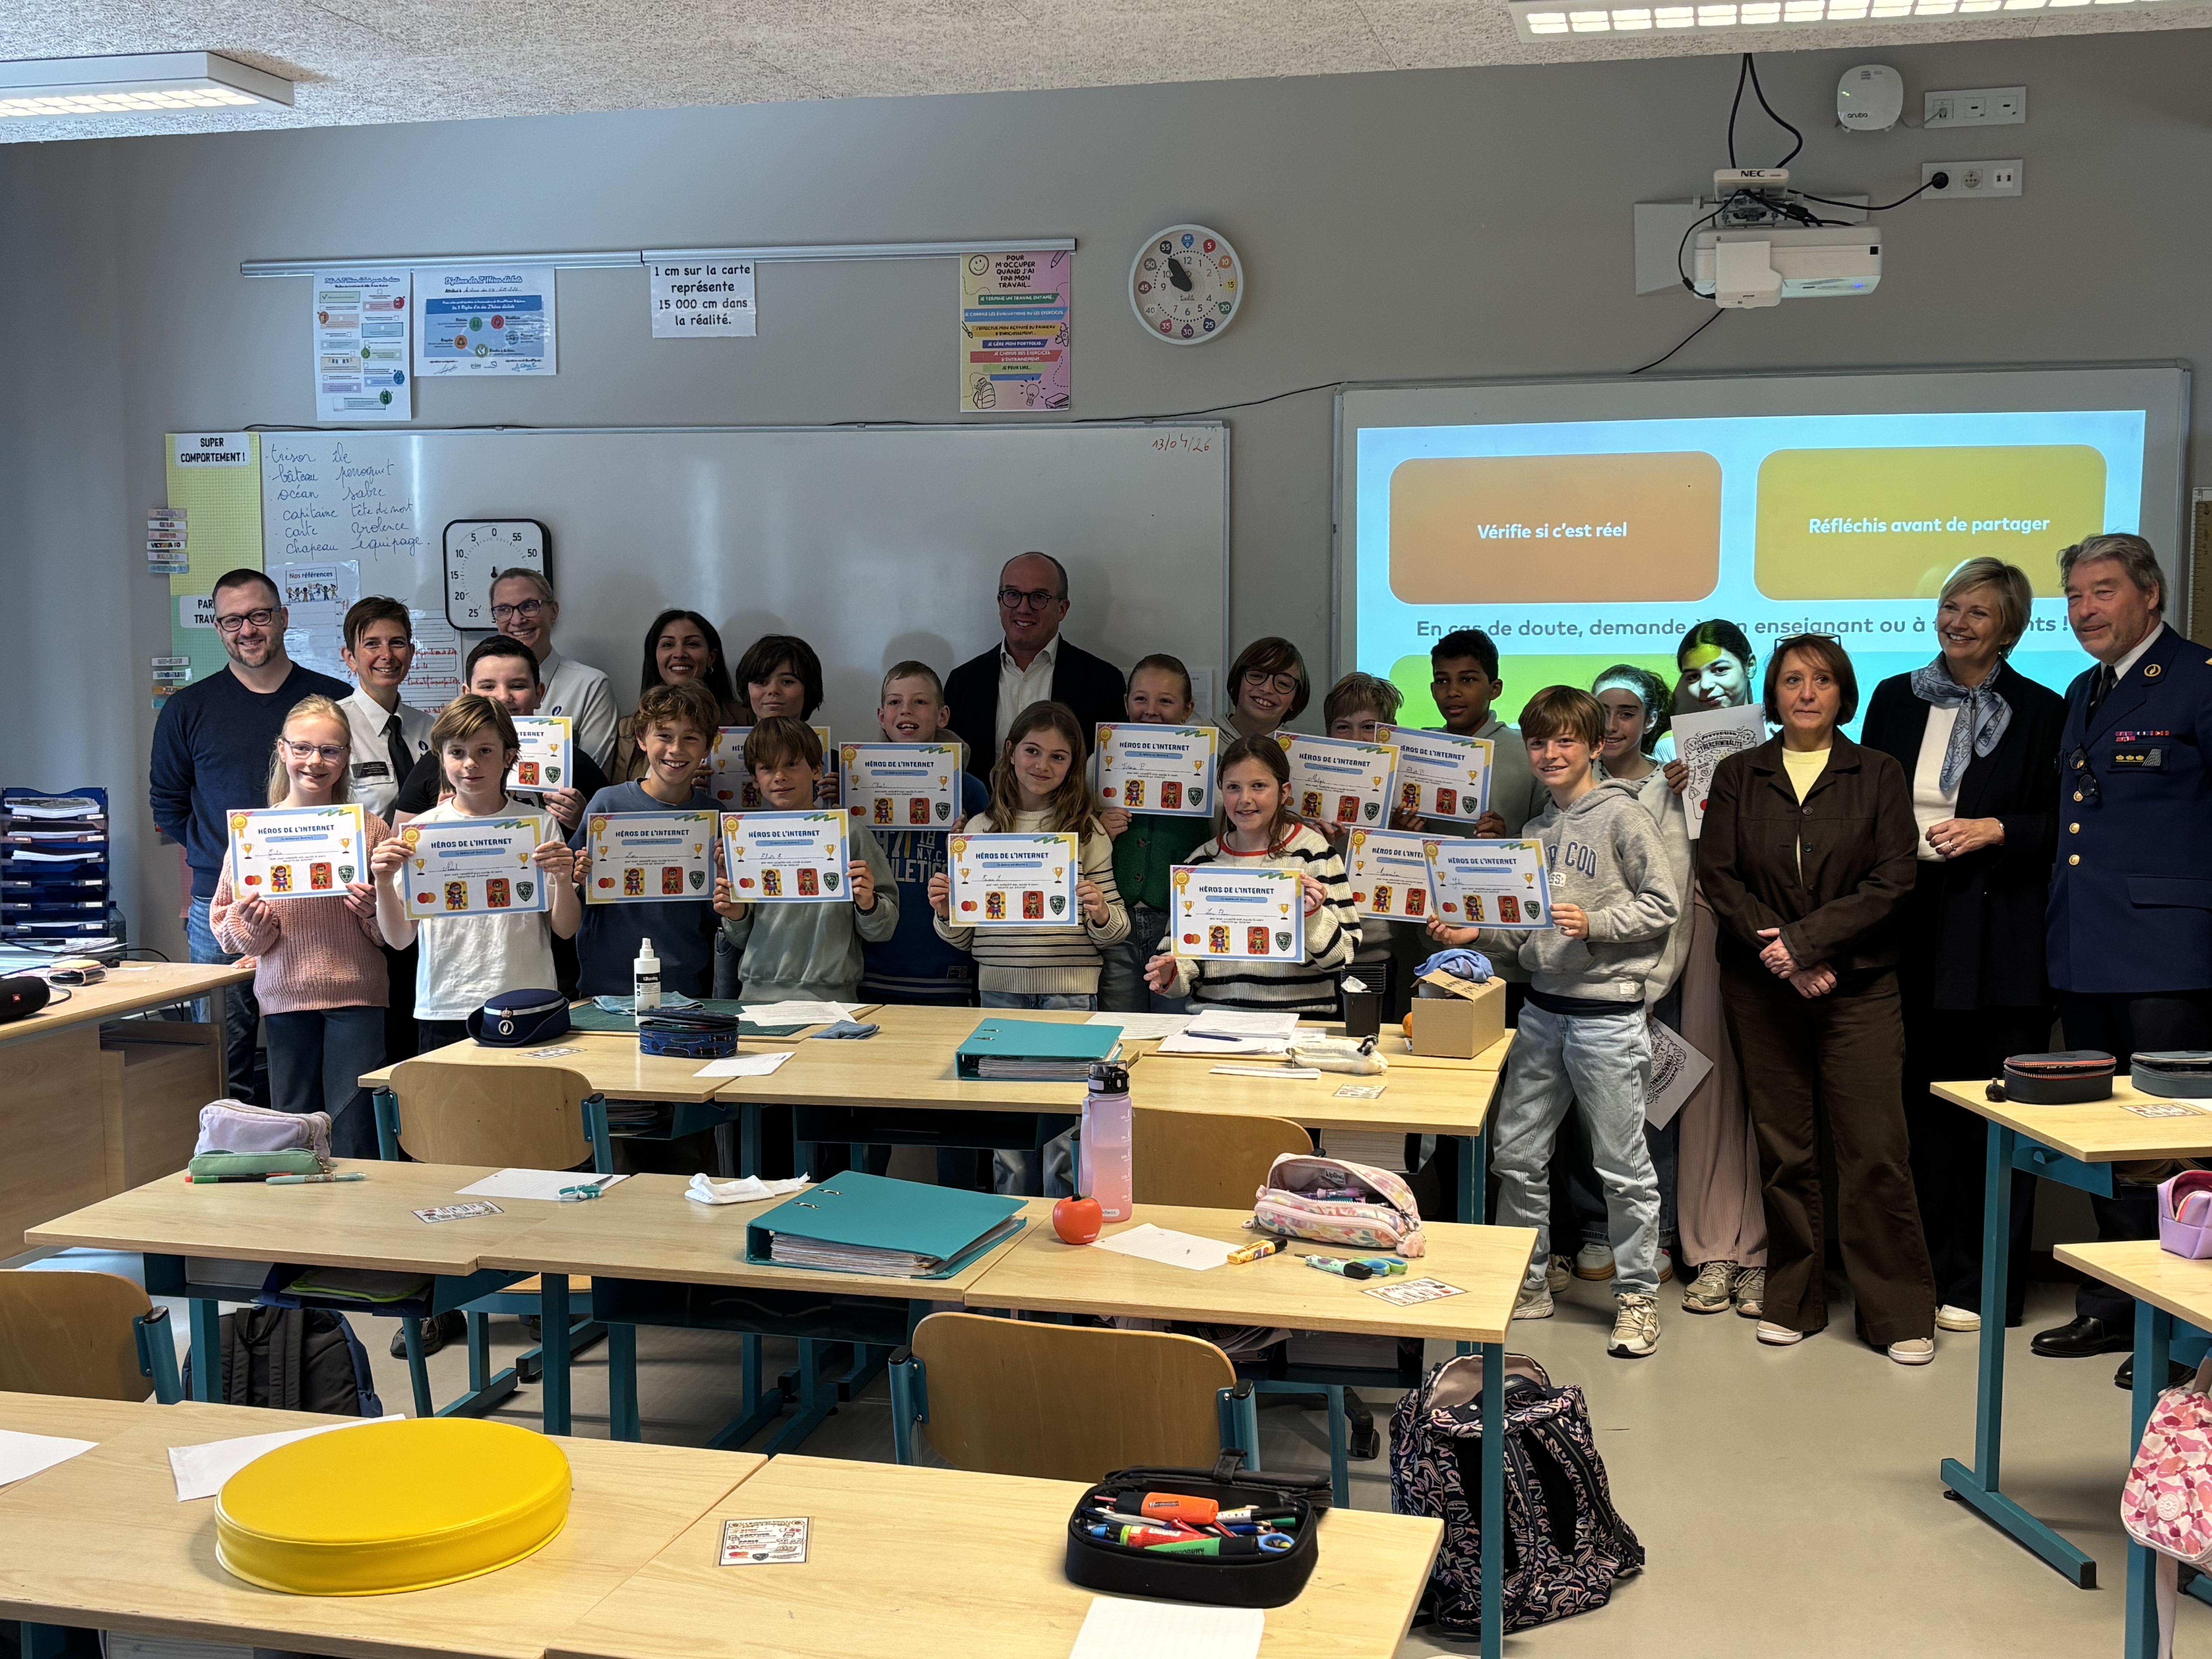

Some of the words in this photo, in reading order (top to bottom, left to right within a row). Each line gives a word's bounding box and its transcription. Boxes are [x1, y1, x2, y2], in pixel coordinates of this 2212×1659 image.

[1183, 256, 1192, 264] 12
[655, 267, 659, 276] 1
[684, 267, 702, 275] sur
[707, 265, 716, 275] la
[722, 264, 750, 274] carte
[672, 280, 734, 295] représente
[659, 299, 671, 309] 15
[676, 299, 697, 309] 000
[723, 298, 747, 308] dans
[1197, 304, 1202, 312] 5
[675, 315, 685, 326] la
[690, 313, 731, 325] réalité.
[200, 438, 224, 447] SUPER
[181, 452, 240, 463] COMPORTEMENT
[243, 452, 245, 462] !
[332, 442, 351, 464] île
[335, 459, 394, 488] perroquet
[278, 484, 319, 500] océan
[343, 481, 386, 500] sabre
[283, 503, 338, 528] capitaine
[351, 502, 373, 517] tête
[285, 520, 318, 538] carte
[351, 517, 409, 534] violence
[1478, 524, 1532, 539] Vérifie
[1535, 523, 1549, 538] si
[1553, 523, 1592, 538] c'est
[1596, 521, 1627, 537] réel
[1809, 517, 1887, 533] Réfléchis
[1891, 519, 1942, 532] avant
[1946, 516, 1968, 531] de
[1972, 519, 2050, 534] partager
[471, 533, 476, 542] 5
[492, 528, 497, 537] 0
[512, 532, 522, 541] 55
[286, 538, 338, 560] chapeau
[456, 549, 464, 558] 10
[527, 548, 537, 557] 50
[451, 571, 459, 579] 15
[455, 592, 465, 600] 20
[198, 599, 215, 609] PAR
[469, 608, 478, 617] 25
[194, 615, 216, 624] TRAV
[1417, 621, 1441, 636] En
[1488, 620, 1512, 636] de
[1518, 620, 1583, 638] doute,
[1590, 618, 1686, 635] demande
[1754, 619, 1873, 634] enseignant
[1880, 621, 1906, 633] ou
[1912, 616, 1926, 633] à
[2063, 617, 2068, 632] !
[431, 840, 457, 848] HÉROS
[917, 847, 945, 862] N.Y.C.
[1649, 1054, 1673, 1088] CYBERCRIMINAL
